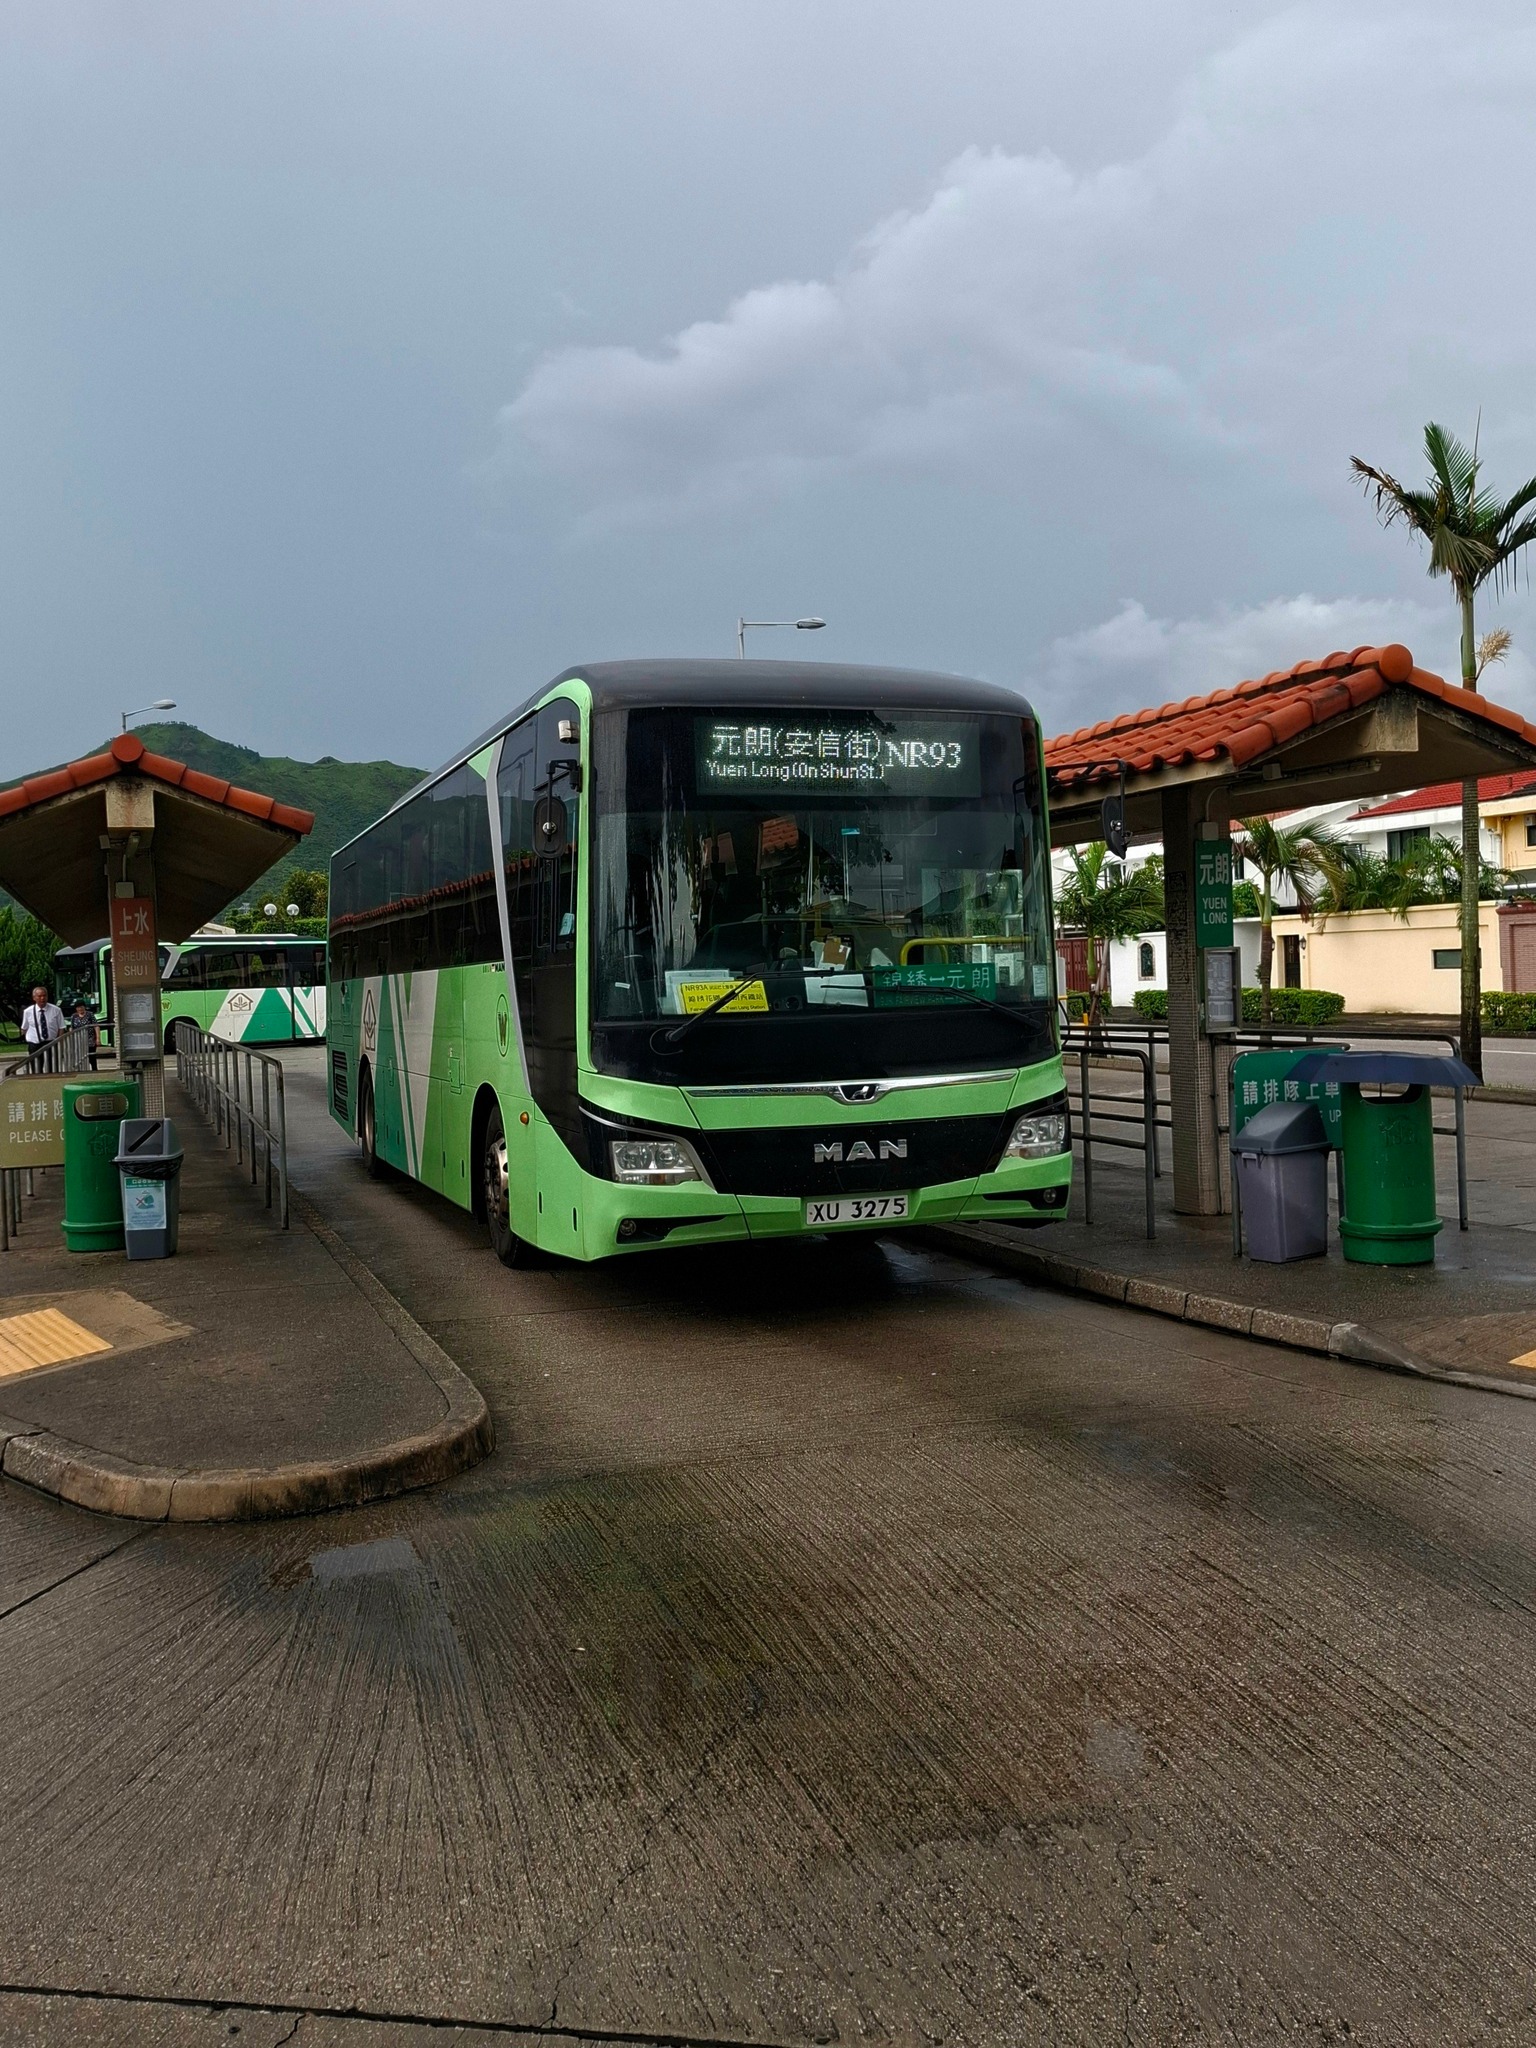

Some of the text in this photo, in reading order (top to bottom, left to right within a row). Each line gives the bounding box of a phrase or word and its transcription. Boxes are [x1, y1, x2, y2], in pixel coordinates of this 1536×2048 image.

[712, 726, 881, 760] 元朗(安信街)
[885, 741, 962, 768] NR93
[706, 760, 747, 777] Yuen
[1200, 852, 1230, 886] 元朗
[1202, 897, 1228, 910] YUEN
[119, 906, 150, 935] 上水
[1203, 912, 1228, 925] LONG
[117, 950, 154, 961] SHEUNG
[124, 965, 148, 976] SHUI
[947, 967, 990, 989] 元朗
[685, 984, 708, 992] NR93A
[1242, 1079, 1340, 1105] 請排隊上車
[1329, 1110, 1342, 1122] UP
[9, 1130, 53, 1143] PLEASE
[814, 1139, 908, 1163] MAN
[812, 1198, 905, 1222] XU 3275
